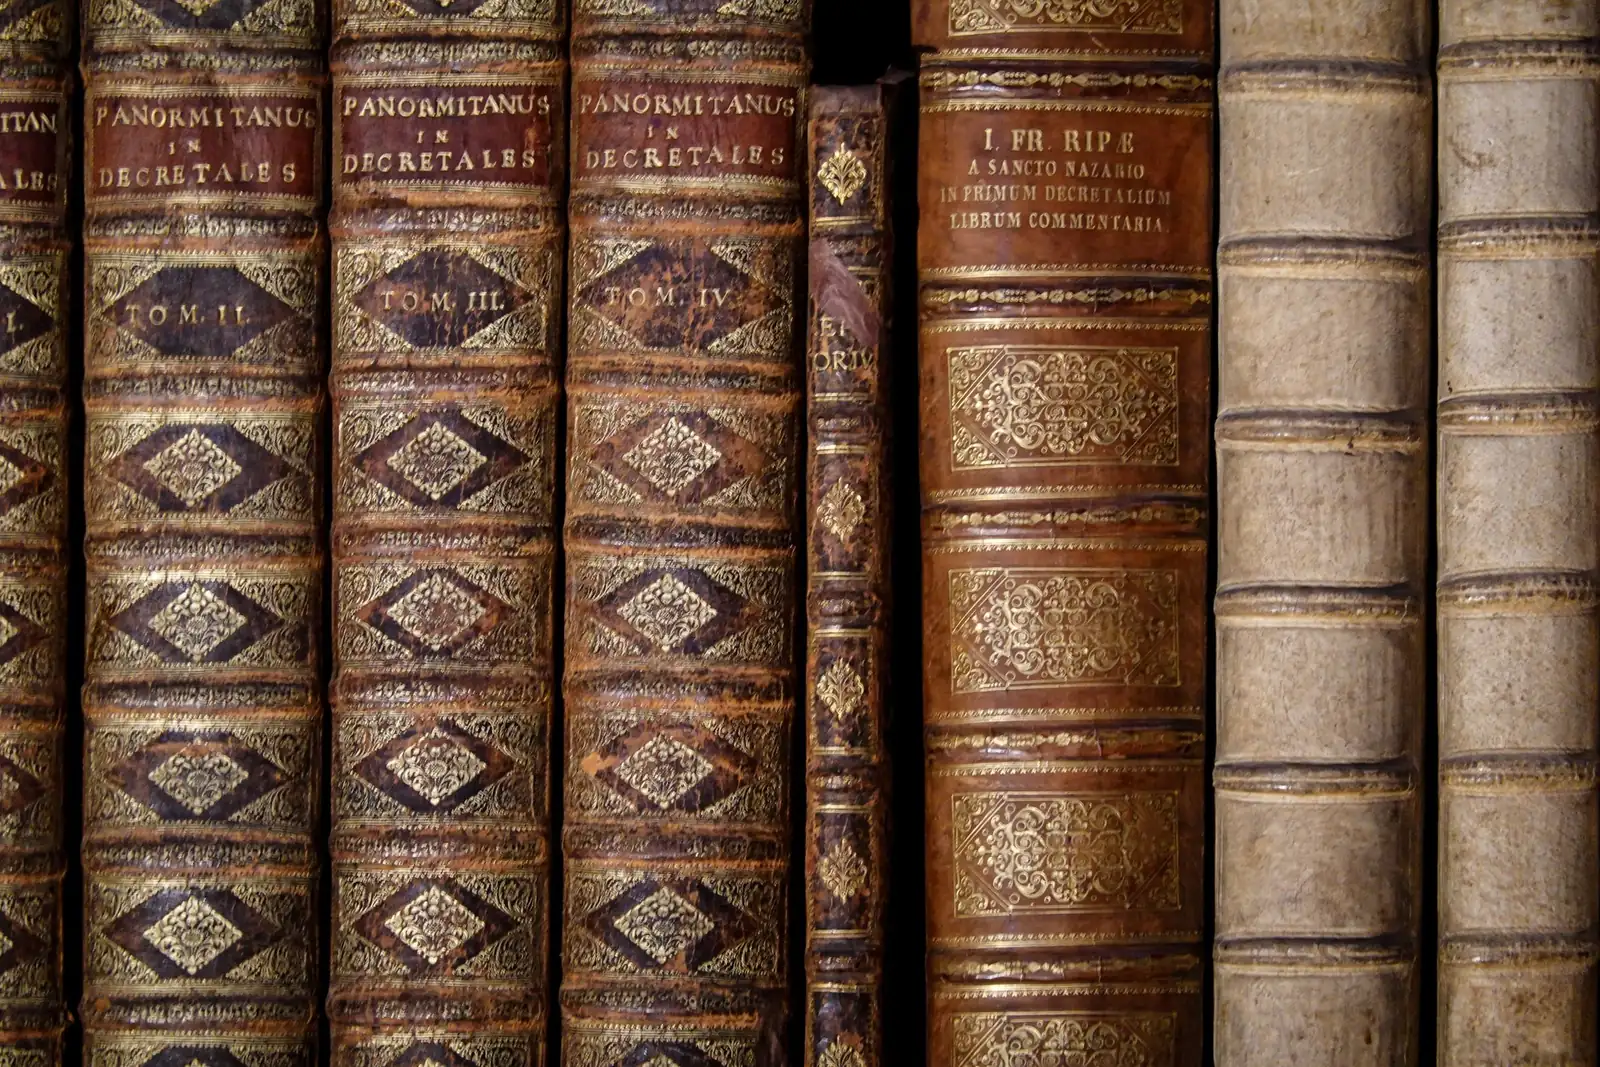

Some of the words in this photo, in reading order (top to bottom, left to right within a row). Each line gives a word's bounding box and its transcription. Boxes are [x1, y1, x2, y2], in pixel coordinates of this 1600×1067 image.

[343, 95, 549, 118] PANORMITANUS
[580, 93, 795, 116] PANORMITANUS
[96, 104, 317, 128] PANORMITANUS
[416, 130, 449, 144] IN
[647, 126, 680, 140] IN
[168, 139, 201, 155] IN
[586, 145, 785, 169] DECRETALES
[343, 148, 537, 175] DECRETALES
[968, 159, 980, 176] A
[988, 159, 1057, 177] SANCTO
[1065, 161, 1145, 179] NAZARIO
[99, 162, 296, 189] DECRETALES
[940, 187, 957, 204] IN
[963, 184, 1037, 203] PRIMUM
[1045, 185, 1171, 206] DECRETALIUM
[950, 211, 1022, 230] LIBRUM
